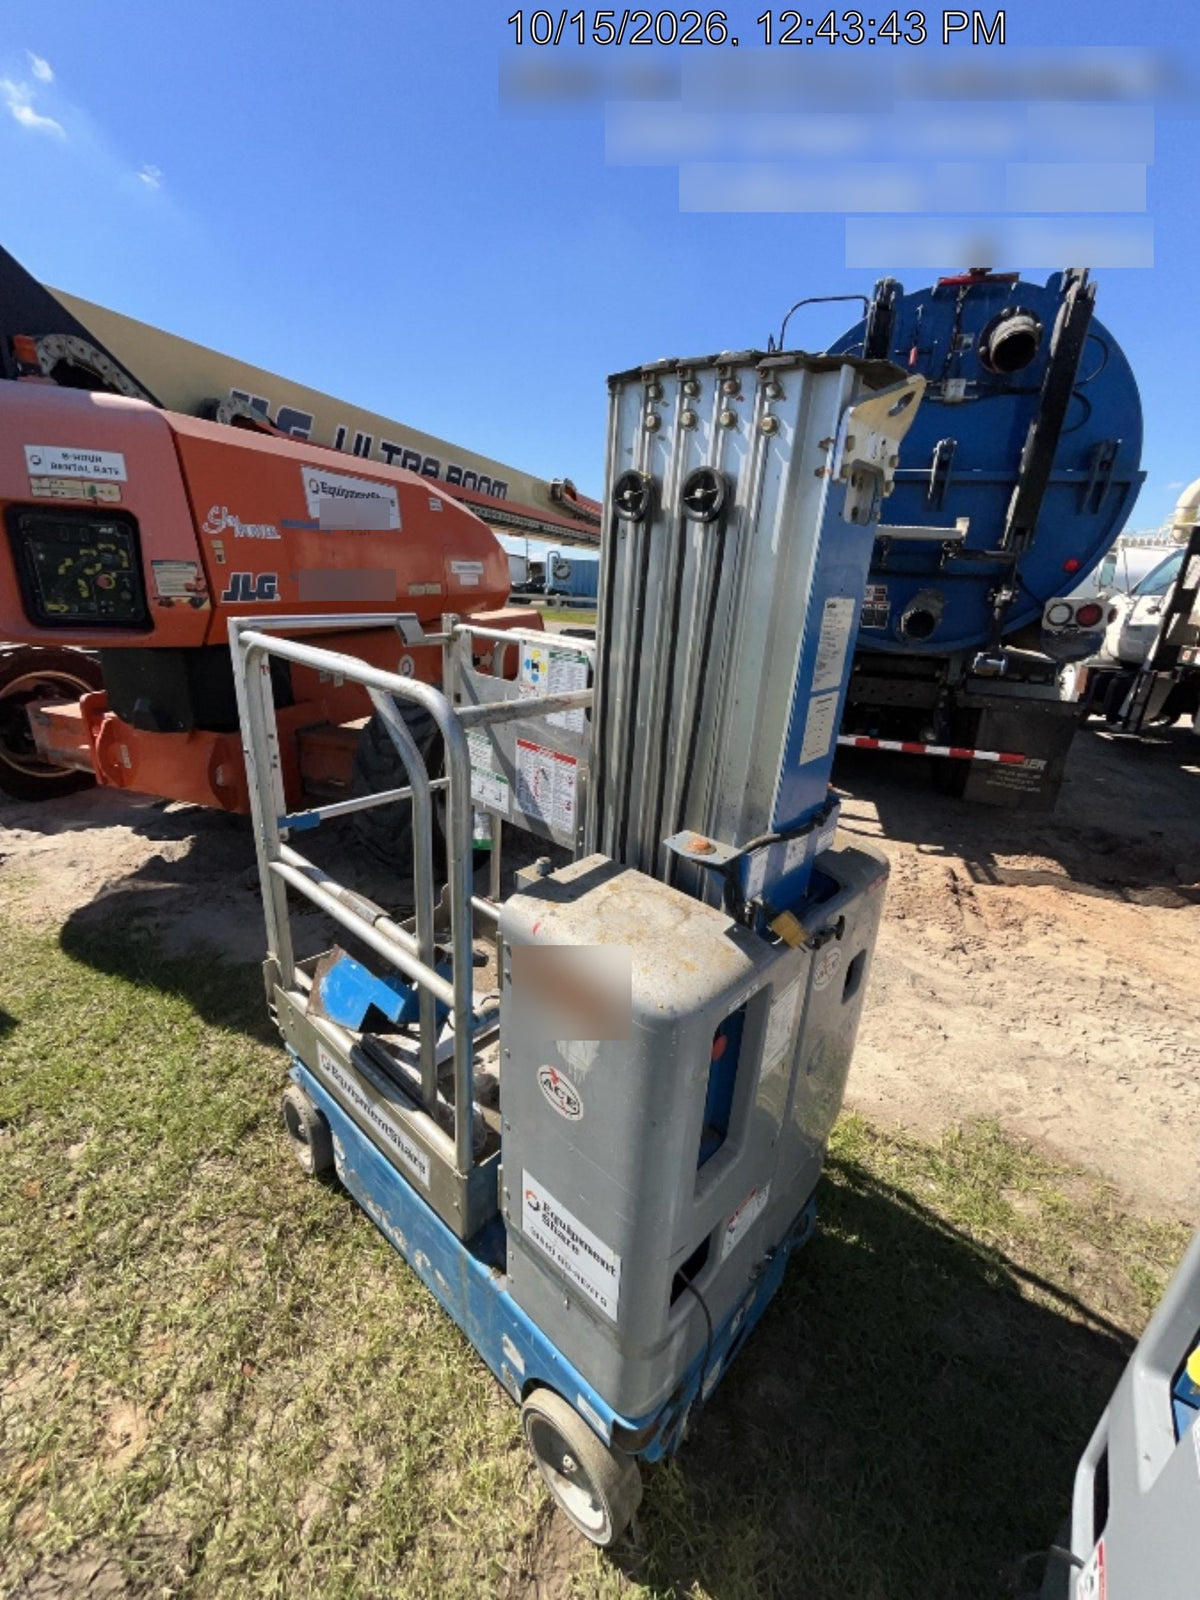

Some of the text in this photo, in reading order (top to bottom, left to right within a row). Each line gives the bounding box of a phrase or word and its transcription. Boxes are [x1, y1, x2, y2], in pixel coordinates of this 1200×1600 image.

[50, 462, 92, 474] RENTAL
[221, 572, 279, 603] JLG
[543, 1078, 577, 1112] ACE
[541, 1212, 580, 1256] Share
[542, 1201, 616, 1278] Equipment
